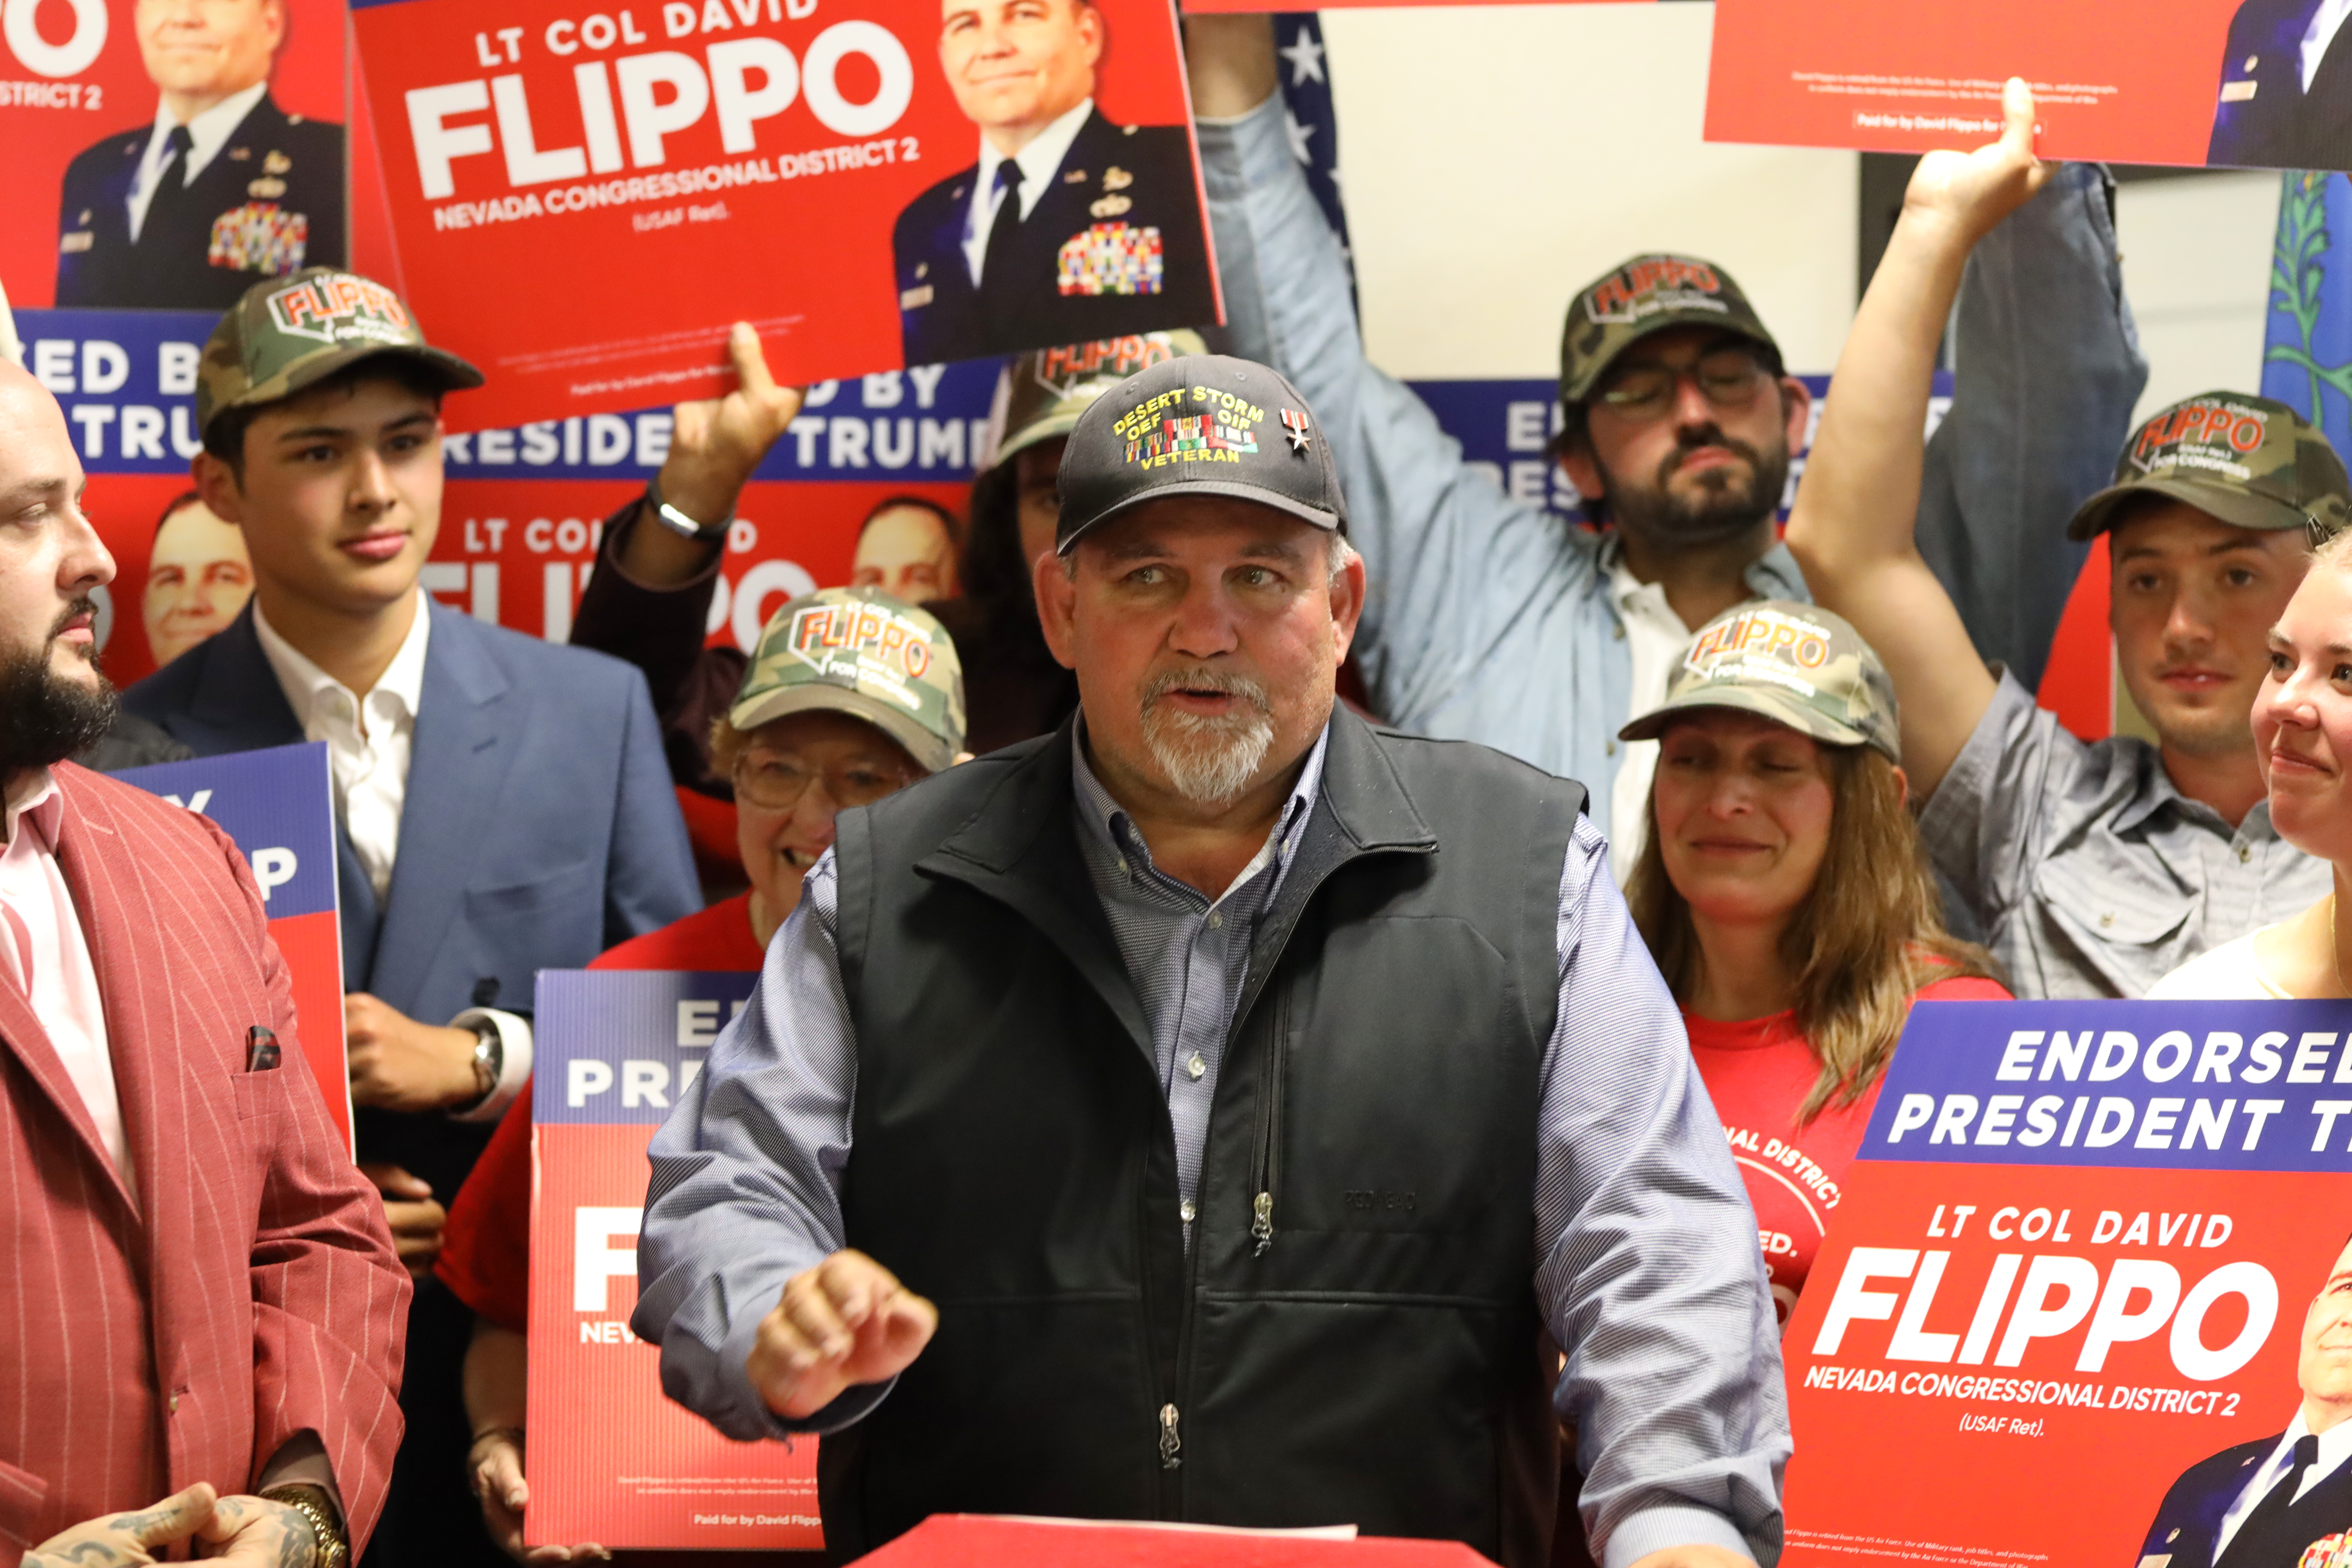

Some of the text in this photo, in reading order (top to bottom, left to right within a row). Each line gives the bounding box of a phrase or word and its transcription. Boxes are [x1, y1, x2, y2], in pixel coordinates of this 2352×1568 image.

[476, 27, 524, 67] LT
[545, 10, 646, 56] COL
[0, 81, 103, 110] STRICT 2
[404, 20, 914, 200] FLIPPO
[1857, 113, 1881, 128] Paid
[1883, 114, 1898, 128] for
[1899, 115, 1913, 132] by
[1914, 116, 1946, 130] David
[1947, 117, 1982, 134] Flippo
[1982, 119, 1999, 133] for
[433, 137, 920, 232] NEVADA CONGRESSIONAL DISTRICT 2
[284, 281, 410, 329] FLIPPO
[72, 403, 205, 459] TRU
[1113, 386, 1265, 436] DESERT STORM
[1126, 409, 1251, 441] OEF OIF
[2136, 405, 2264, 458] FLIPPO
[1141, 448, 1240, 471] VETERAN
[464, 518, 509, 554] LT
[799, 609, 931, 678] FLIPPO
[1692, 617, 1829, 669] FLIPPO
[829, 661, 857, 678] FOR
[1887, 1093, 2285, 1151] PRESIDENT
[1926, 1204, 2233, 1248] LT COL DAVID
[1811, 1246, 2279, 1381] FLIPPO
[1803, 1365, 2241, 1416] NEVADA CONGRESSIONAL DISTRICT 2
[1959, 1413, 2044, 1438] (USAF Ret).
[695, 1514, 720, 1525] Paid
[721, 1514, 738, 1525] for
[739, 1514, 755, 1527] by
[756, 1514, 790, 1525] David
[1842, 1546, 1860, 1554] imply
[1860, 1547, 1901, 1557] endorsement
[1901, 1550, 1910, 1560] by
[1931, 1554, 1949, 1563] Force
[1969, 1558, 2008, 1568] Department
[1924, 1542, 1949, 1553] Military
[2008, 1551, 2049, 1562] photographs
